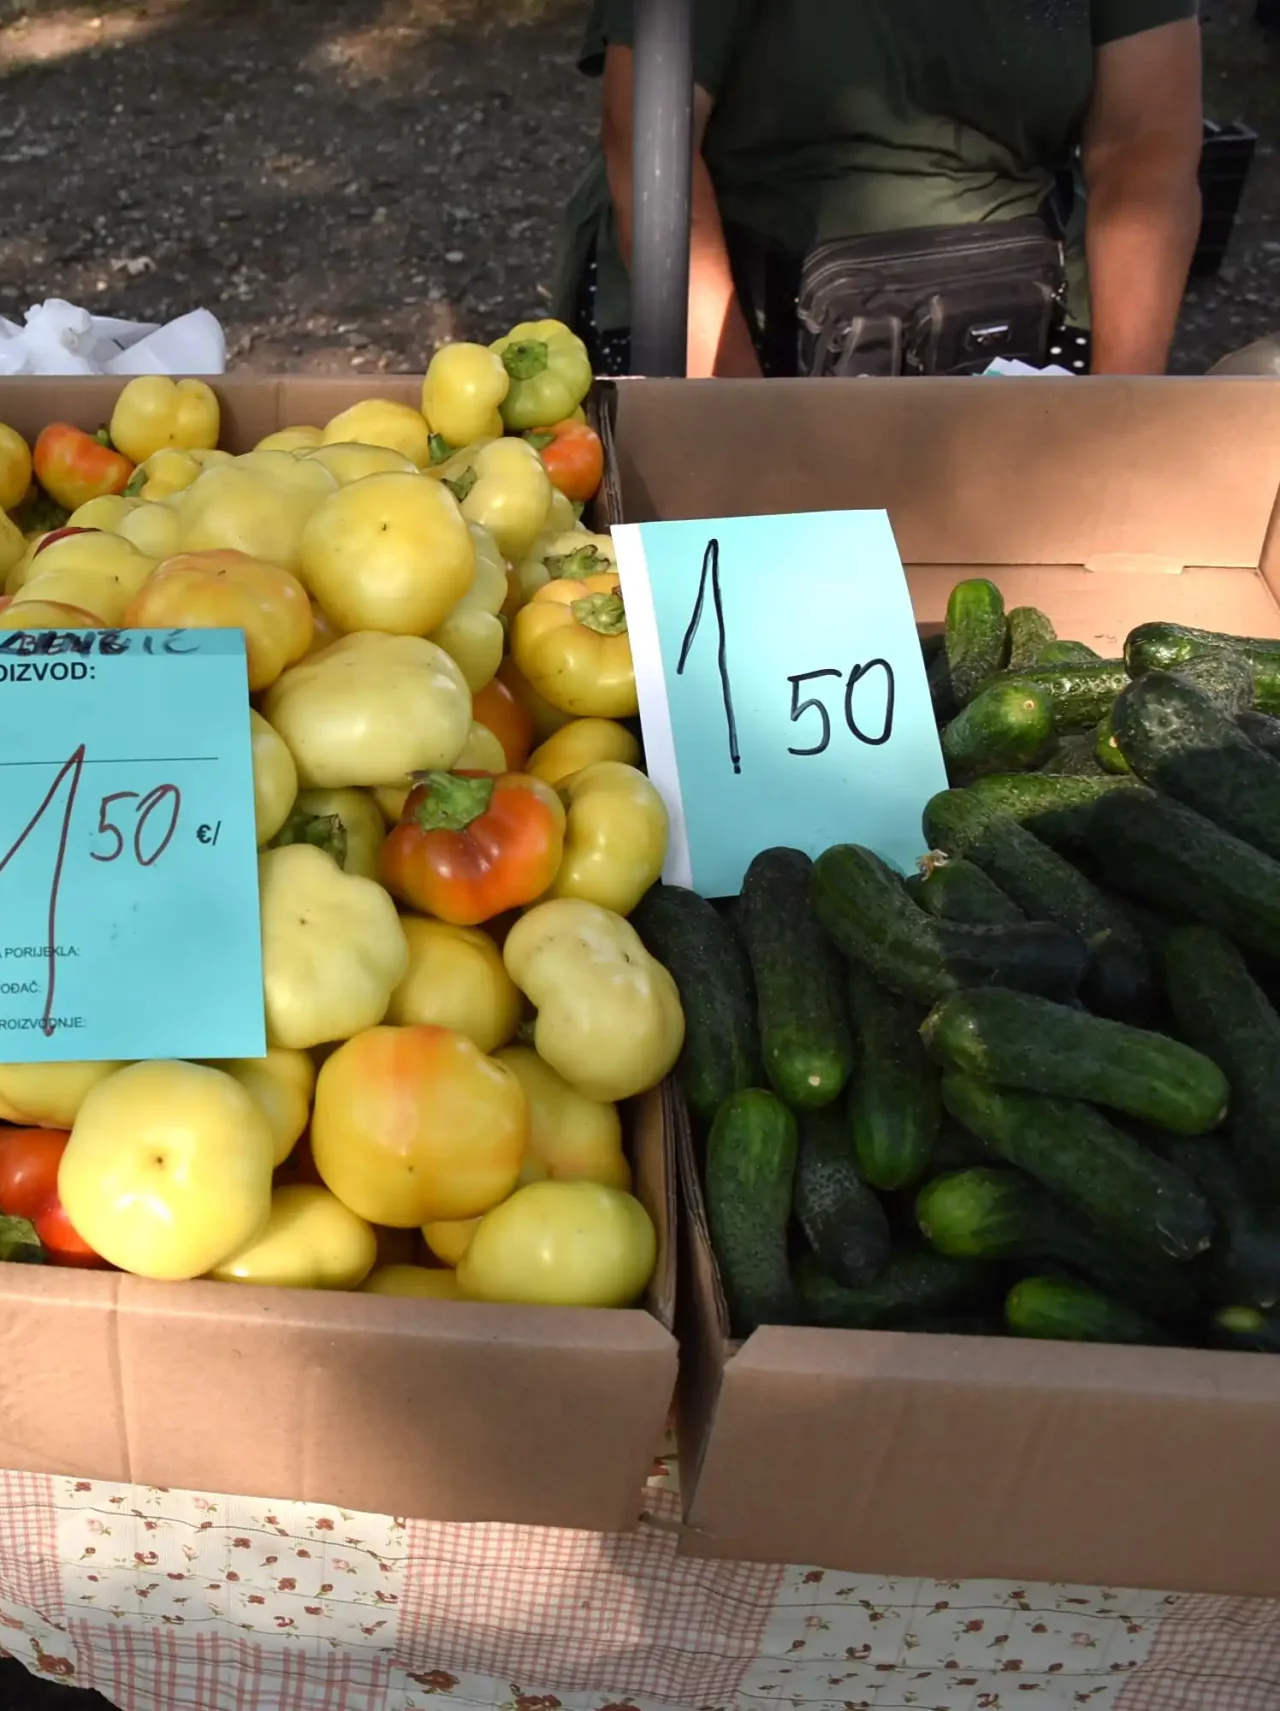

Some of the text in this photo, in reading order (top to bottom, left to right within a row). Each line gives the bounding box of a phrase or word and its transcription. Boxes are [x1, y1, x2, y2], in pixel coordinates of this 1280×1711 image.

[677, 538, 895, 774] 1 50
[90, 784, 181, 866] 50
[196, 821, 221, 846] €/
[4, 946, 80, 958] PORIJEKLA:
